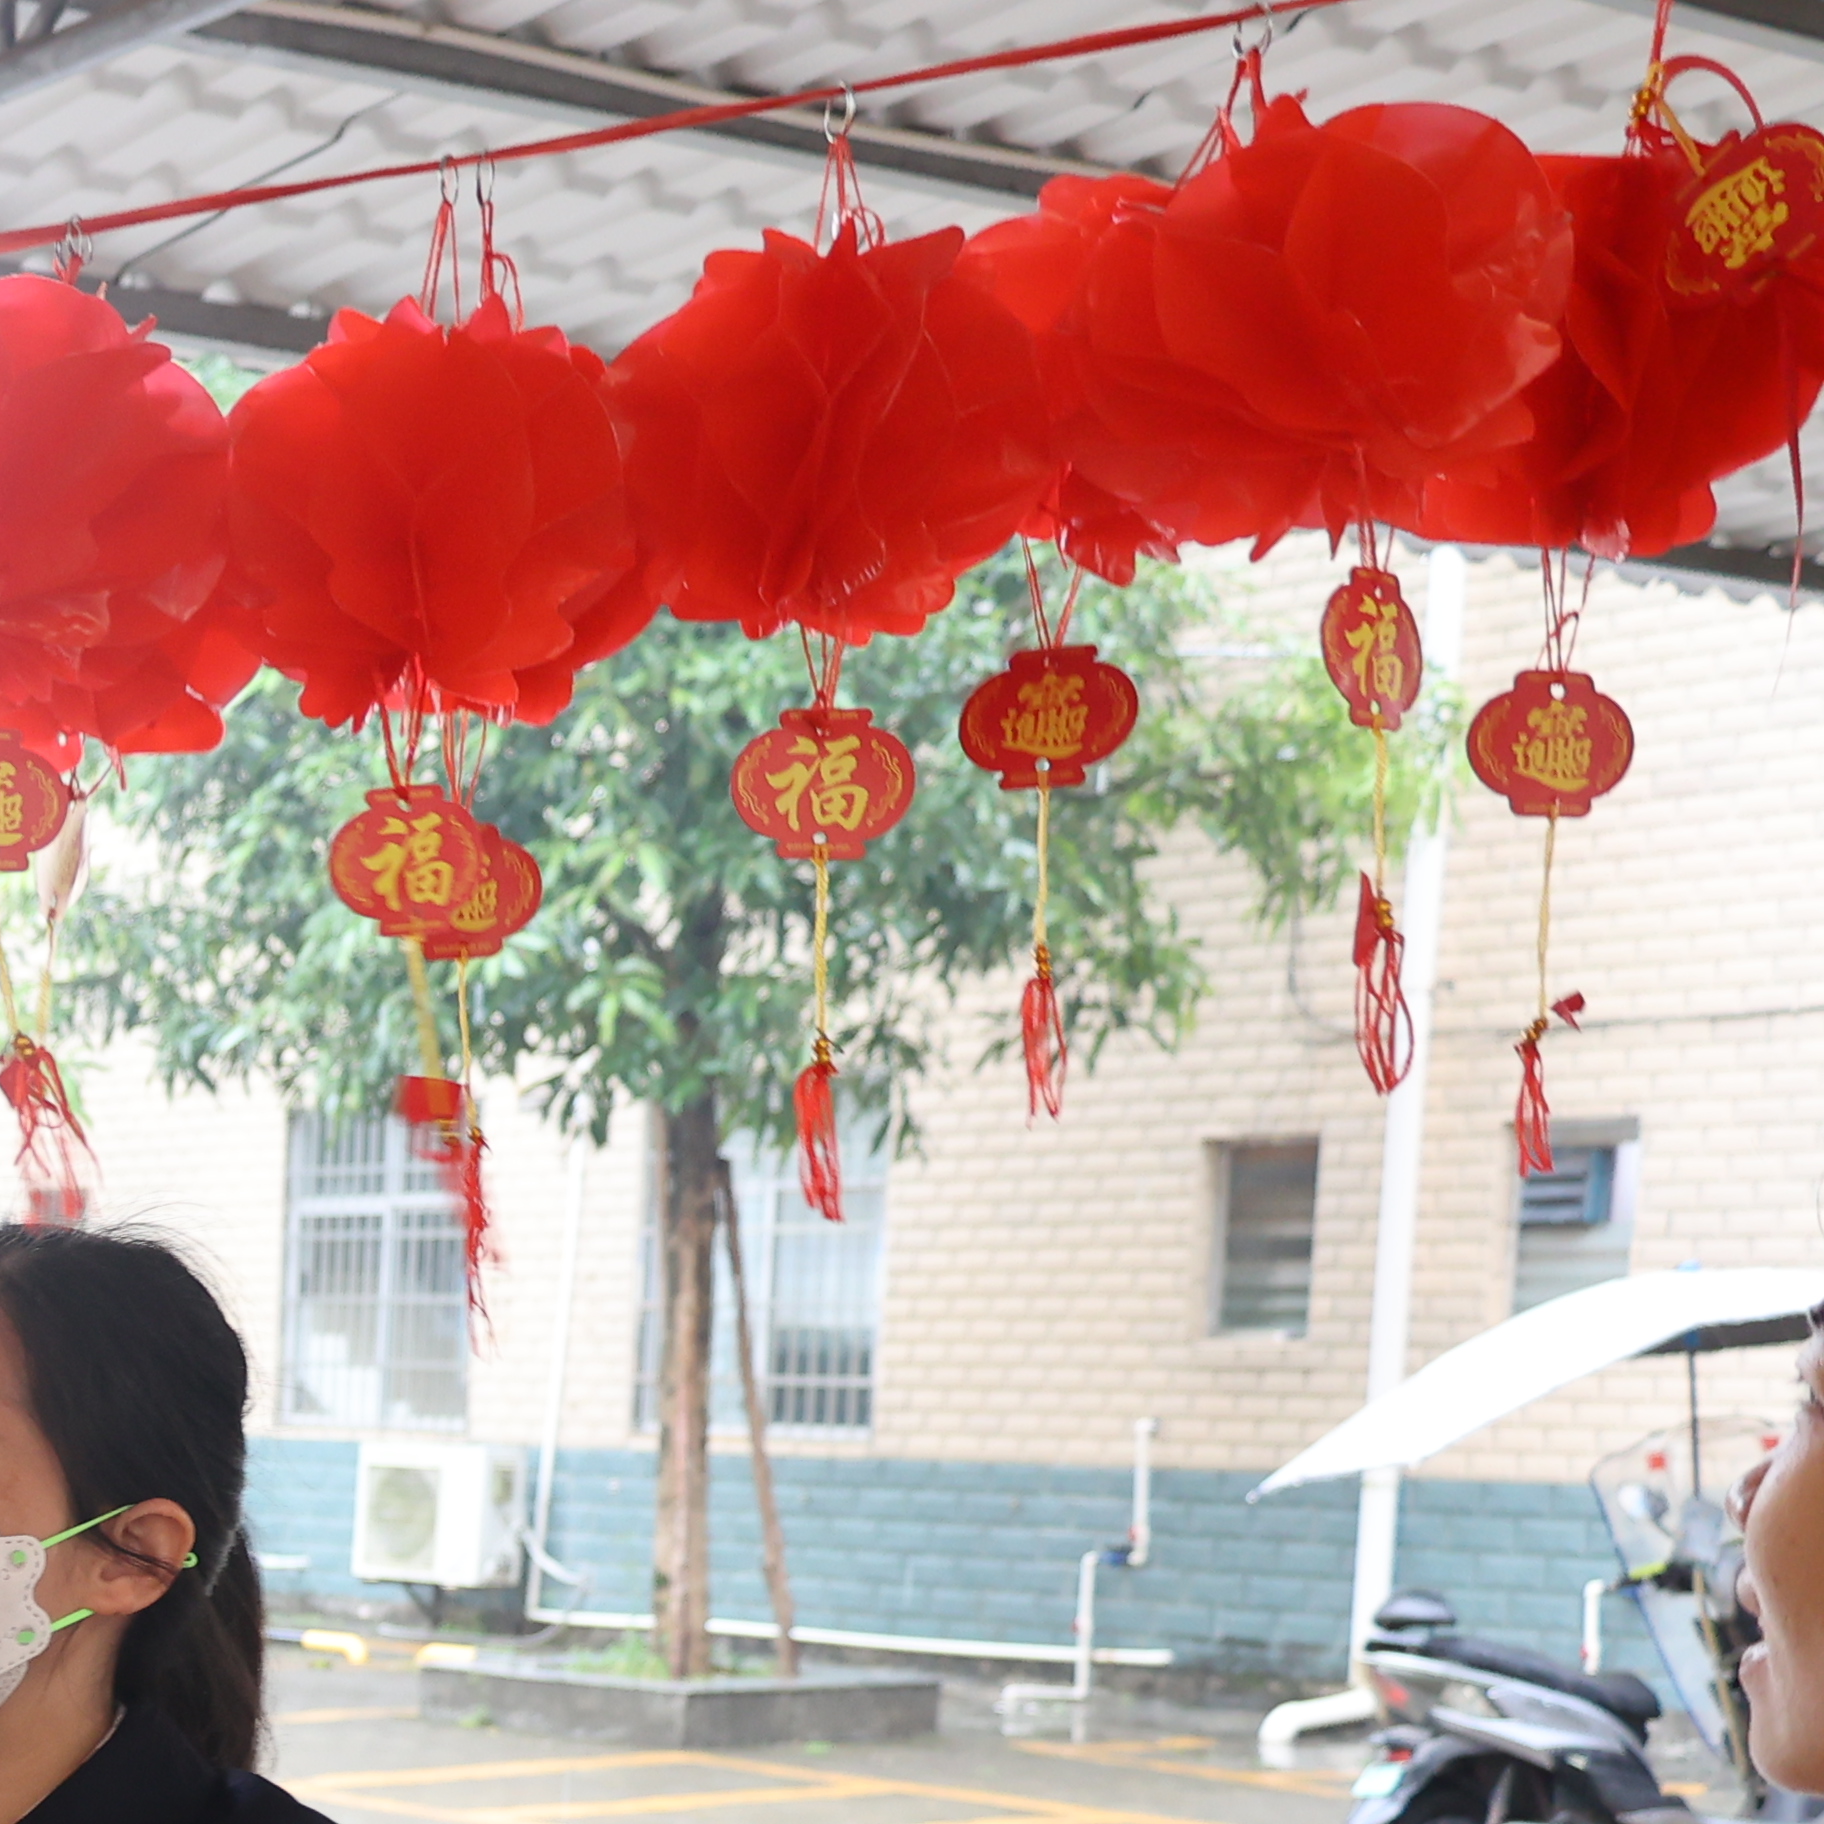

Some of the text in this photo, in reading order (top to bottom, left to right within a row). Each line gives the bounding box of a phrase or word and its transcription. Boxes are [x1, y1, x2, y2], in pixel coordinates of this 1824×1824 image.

[1344, 593, 1403, 699] 福
[764, 734, 870, 830] 福
[359, 811, 455, 911] 福
